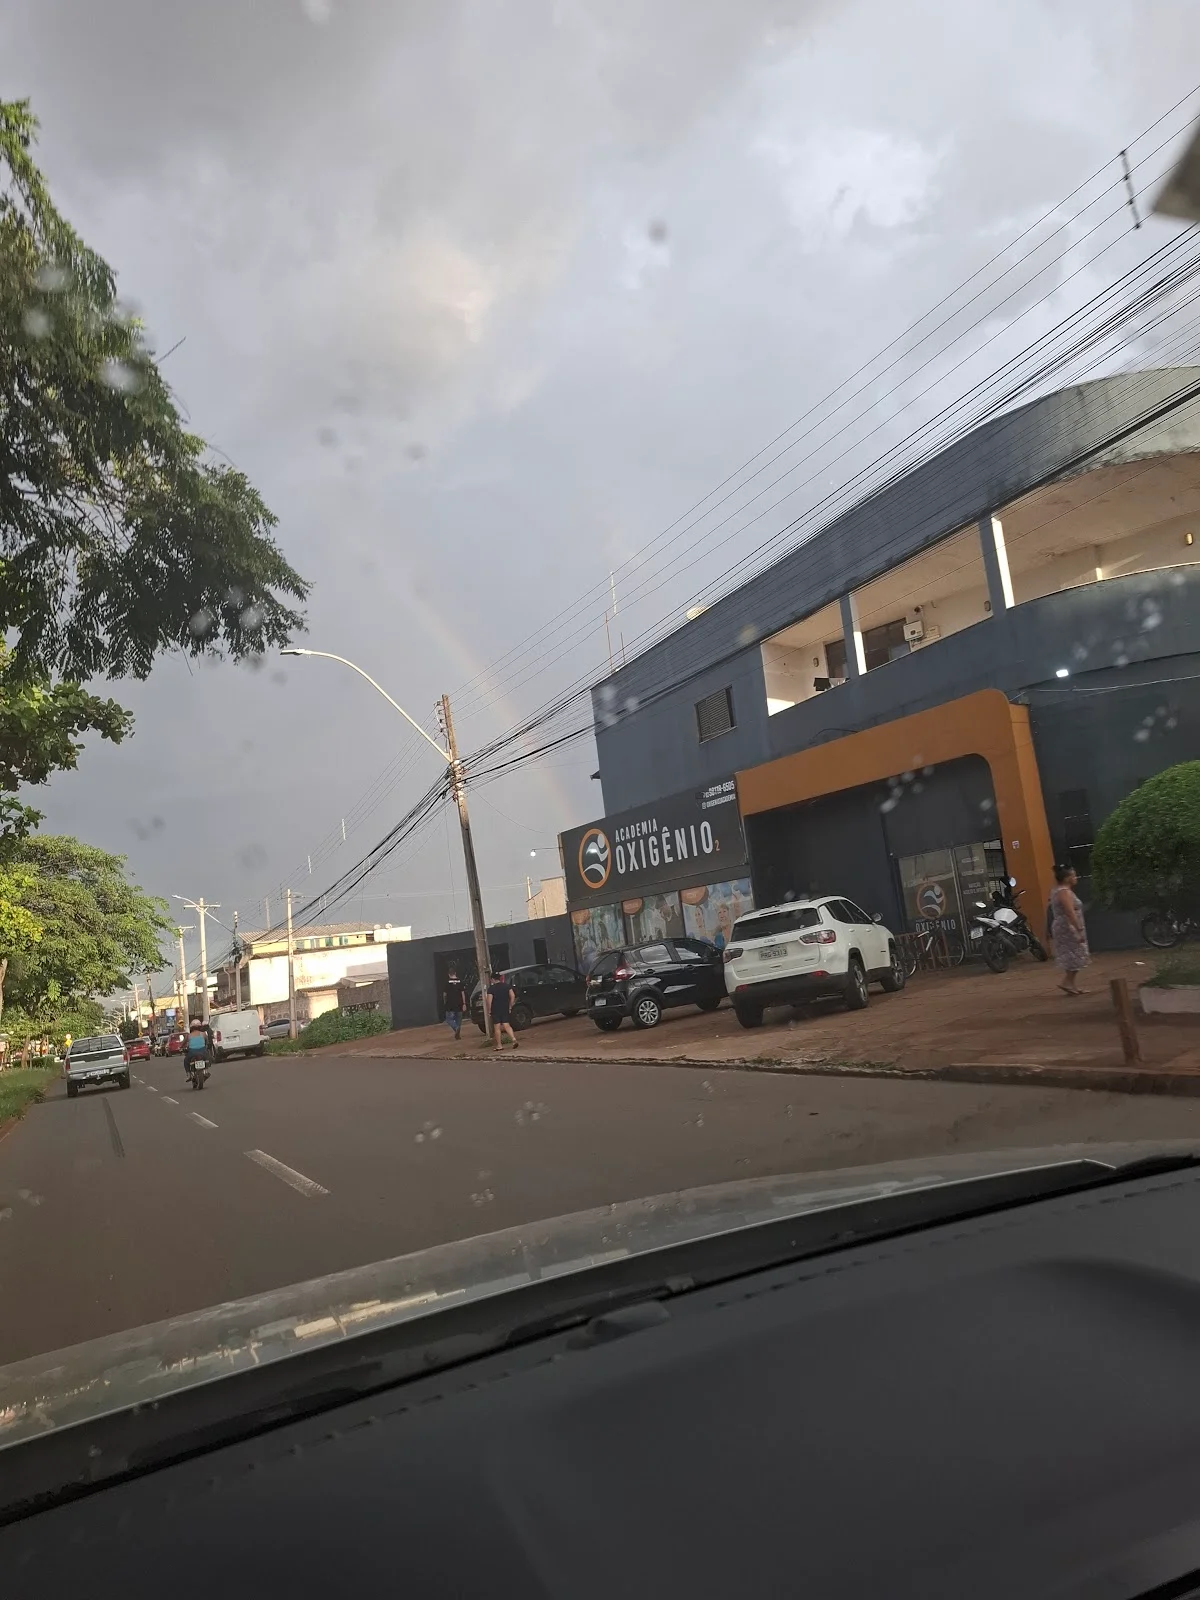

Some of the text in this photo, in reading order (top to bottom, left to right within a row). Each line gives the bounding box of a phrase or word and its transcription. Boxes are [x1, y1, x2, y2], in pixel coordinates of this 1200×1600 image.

[615, 818, 658, 843] ACADEMIA
[615, 821, 721, 875] OXIGÊNIO 2
